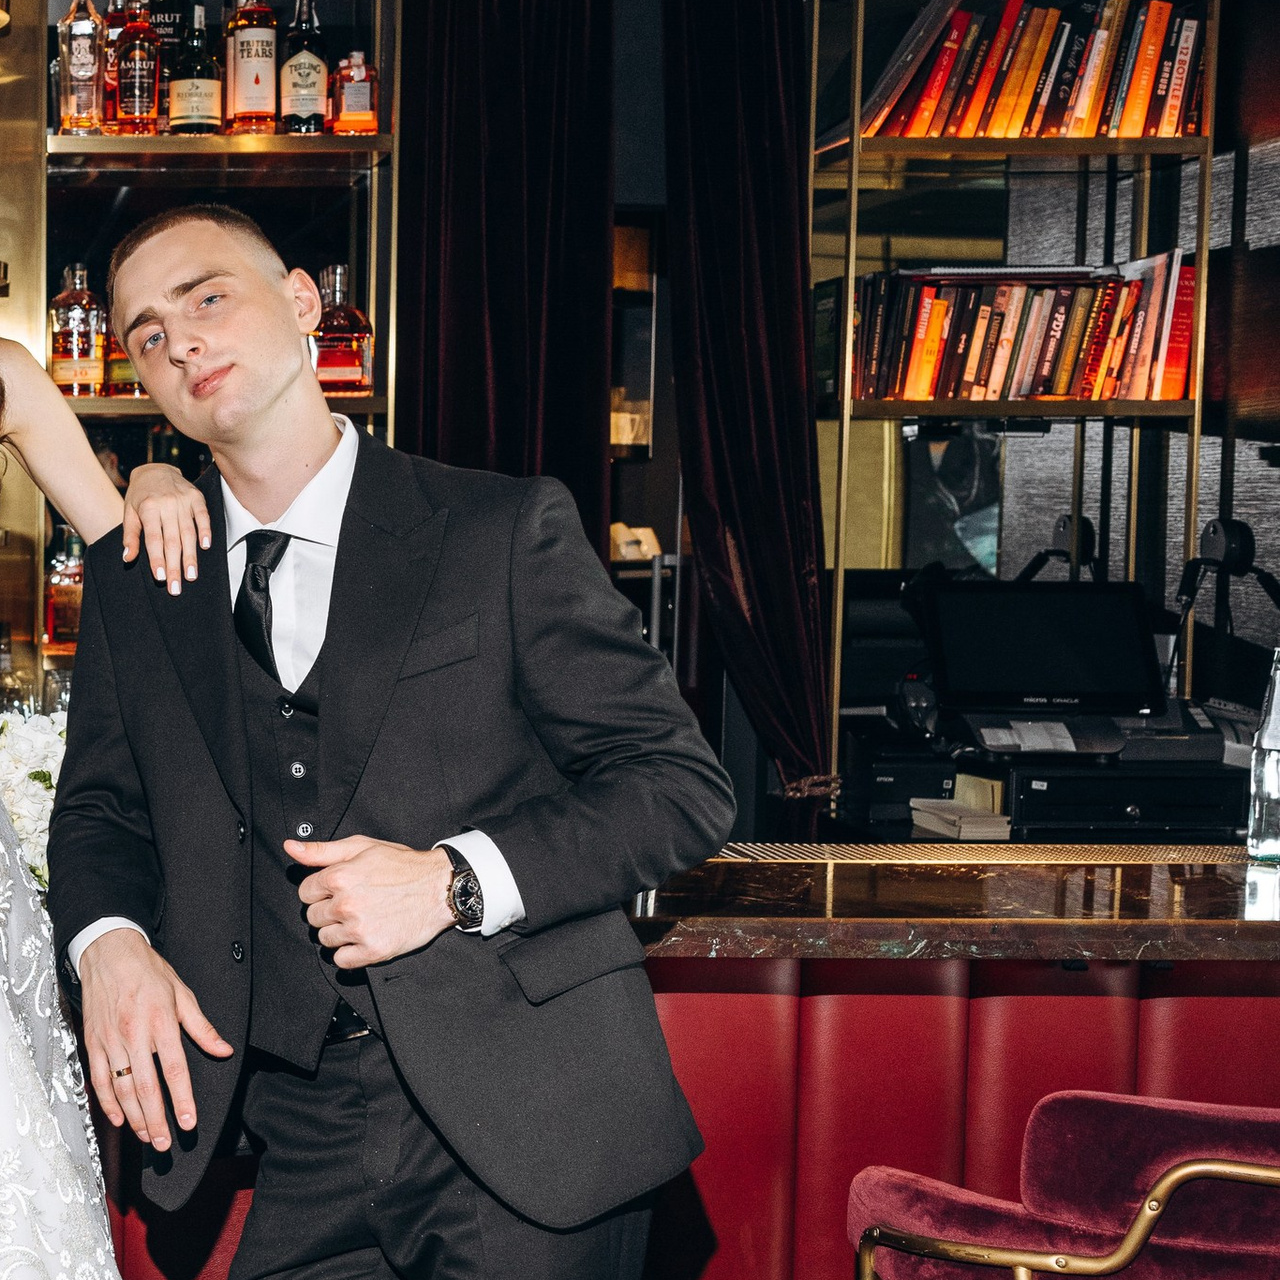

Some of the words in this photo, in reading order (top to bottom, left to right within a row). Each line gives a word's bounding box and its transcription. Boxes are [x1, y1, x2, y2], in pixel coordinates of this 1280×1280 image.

[149, 13, 182, 23] MRUT
[239, 48, 273, 59] TEARS
[1180, 46, 1190, 57] 12
[121, 60, 155, 69] AMRUT
[289, 62, 321, 74] TEELING
[1157, 60, 1172, 95] SHRUBS
[1171, 59, 1187, 101] BOTTLE
[1166, 104, 1179, 127] BAR
[917, 297, 933, 339] APERITIVO
[1049, 312, 1066, 339] PDT
